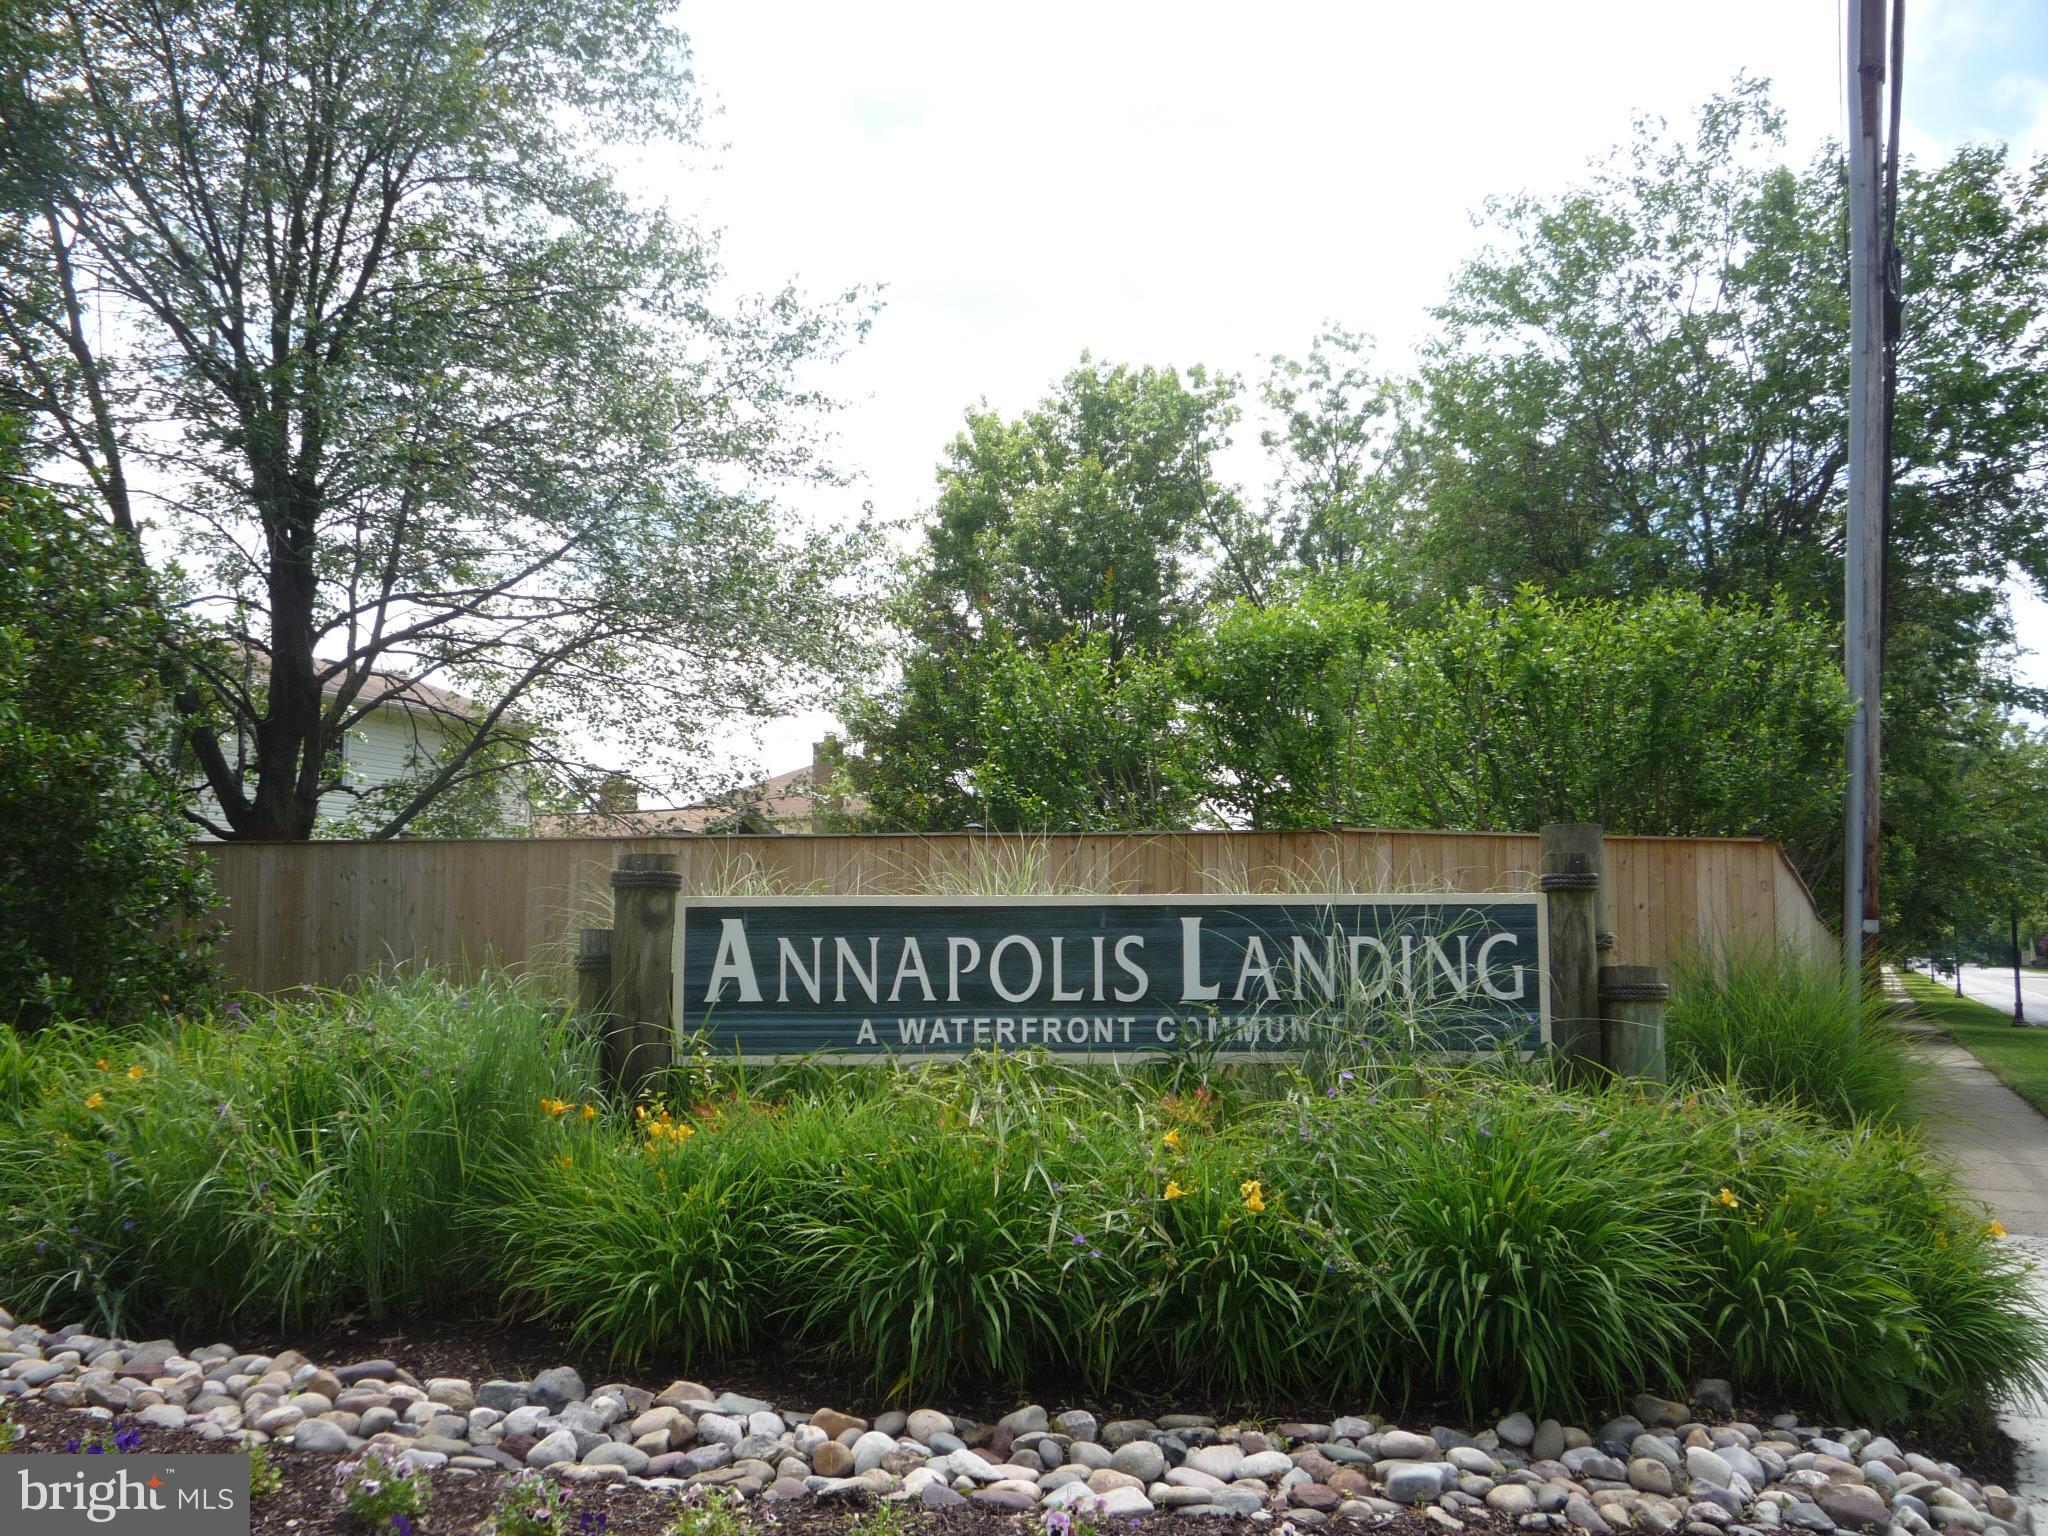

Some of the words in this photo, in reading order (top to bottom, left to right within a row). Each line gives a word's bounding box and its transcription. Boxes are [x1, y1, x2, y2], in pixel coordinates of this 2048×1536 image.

[704, 917, 1149, 1004] ANNAPOLIS
[1180, 916, 1526, 1002] LANDING
[856, 1018, 877, 1045] A
[898, 1016, 1136, 1044] WATERFRONT
[1156, 1015, 1366, 1044] COMMUN
